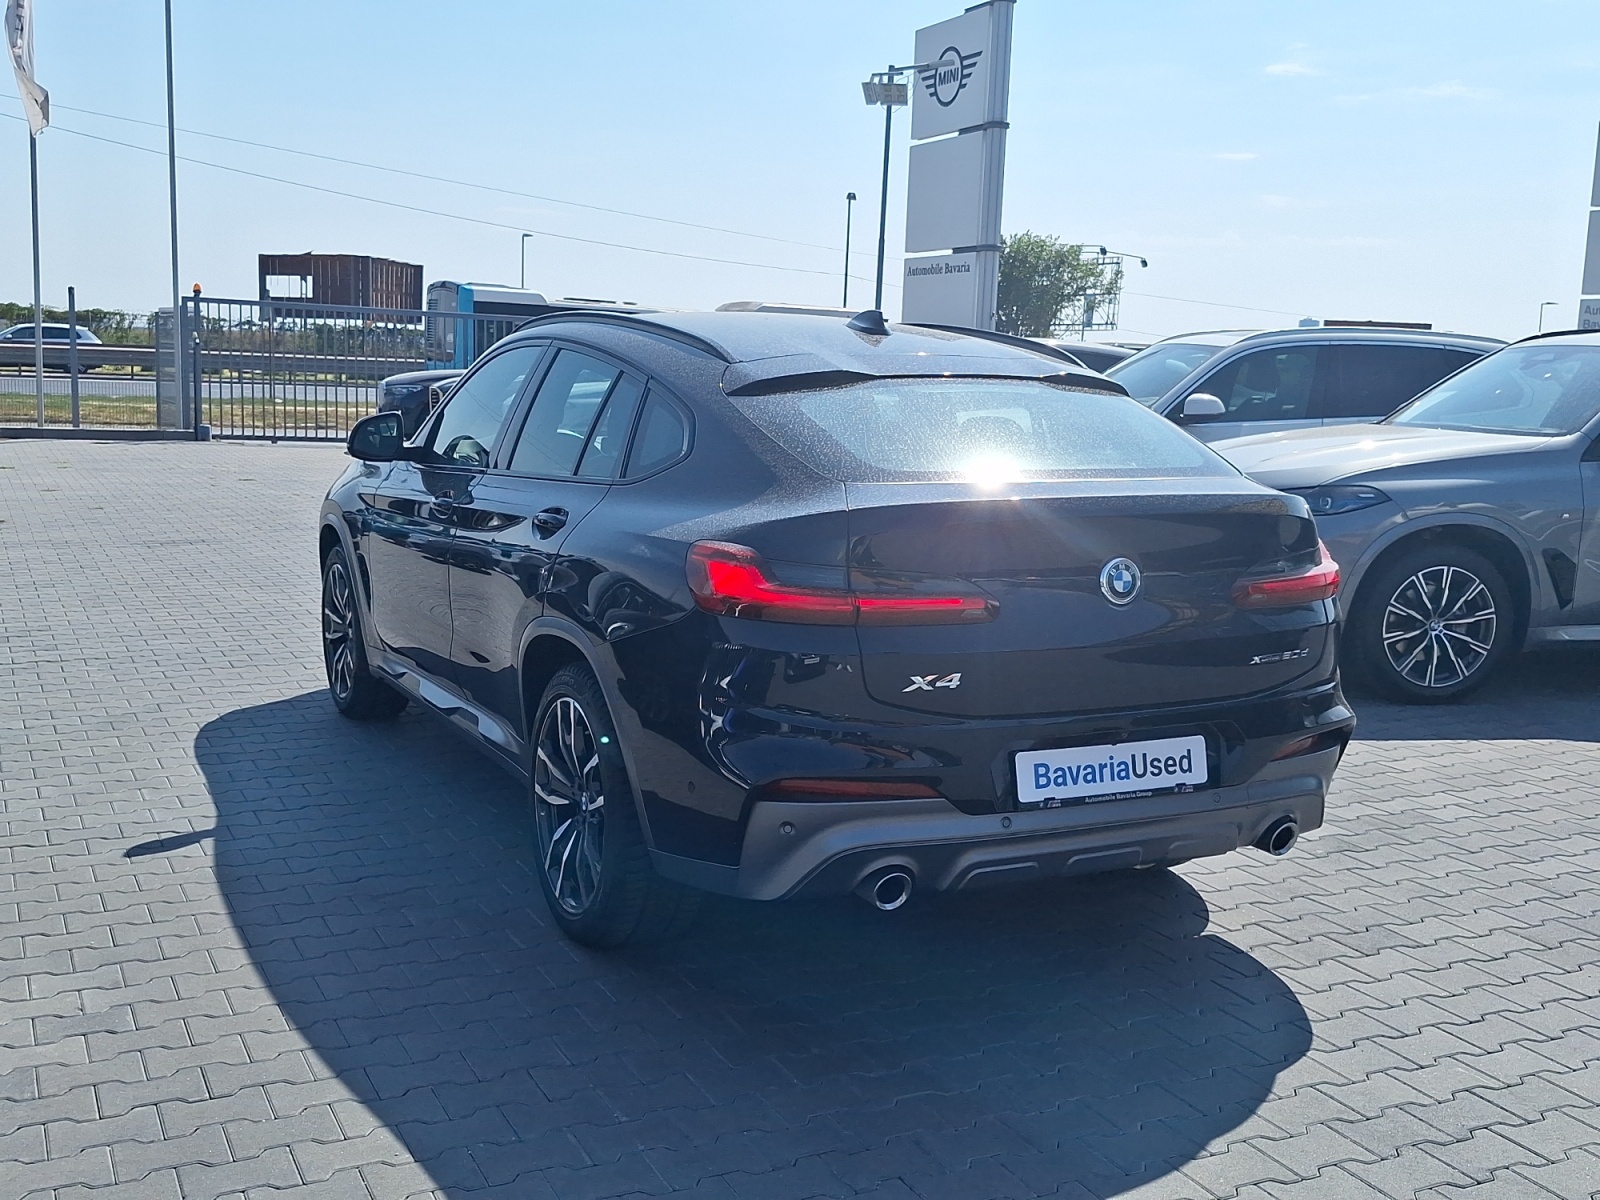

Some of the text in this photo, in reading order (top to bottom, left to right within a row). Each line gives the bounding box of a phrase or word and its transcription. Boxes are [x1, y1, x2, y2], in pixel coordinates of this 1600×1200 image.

[938, 67, 959, 87] MINI
[907, 261, 970, 276] Automobile Bavaria
[901, 672, 962, 693] X4
[1033, 748, 1193, 790] BavariaUsed
[1084, 790, 1153, 803] Automobile Bavaria Group
